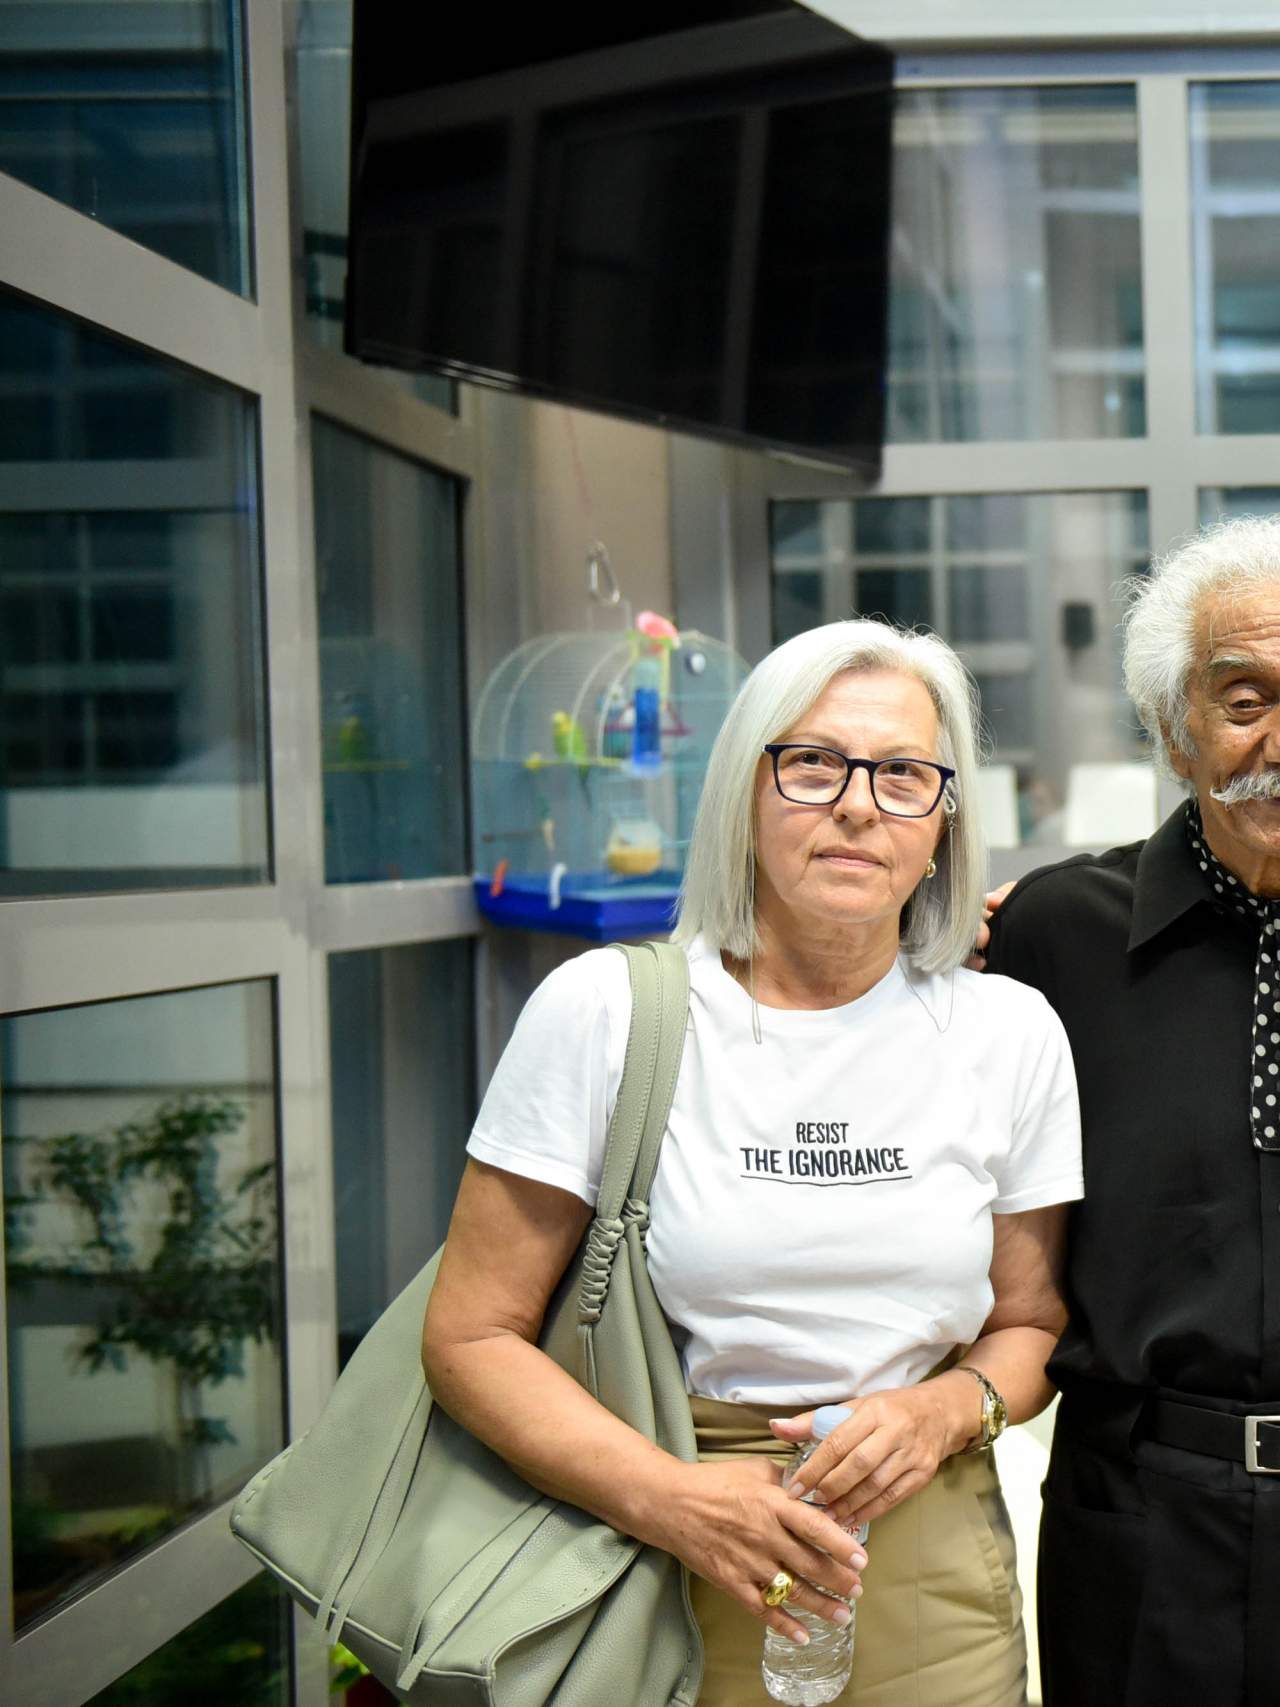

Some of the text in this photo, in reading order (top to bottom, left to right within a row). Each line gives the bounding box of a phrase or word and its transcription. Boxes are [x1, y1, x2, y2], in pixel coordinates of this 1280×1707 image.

[796, 1122, 849, 1144] RESIST
[739, 1147, 909, 1178] THE IGNORANCE
